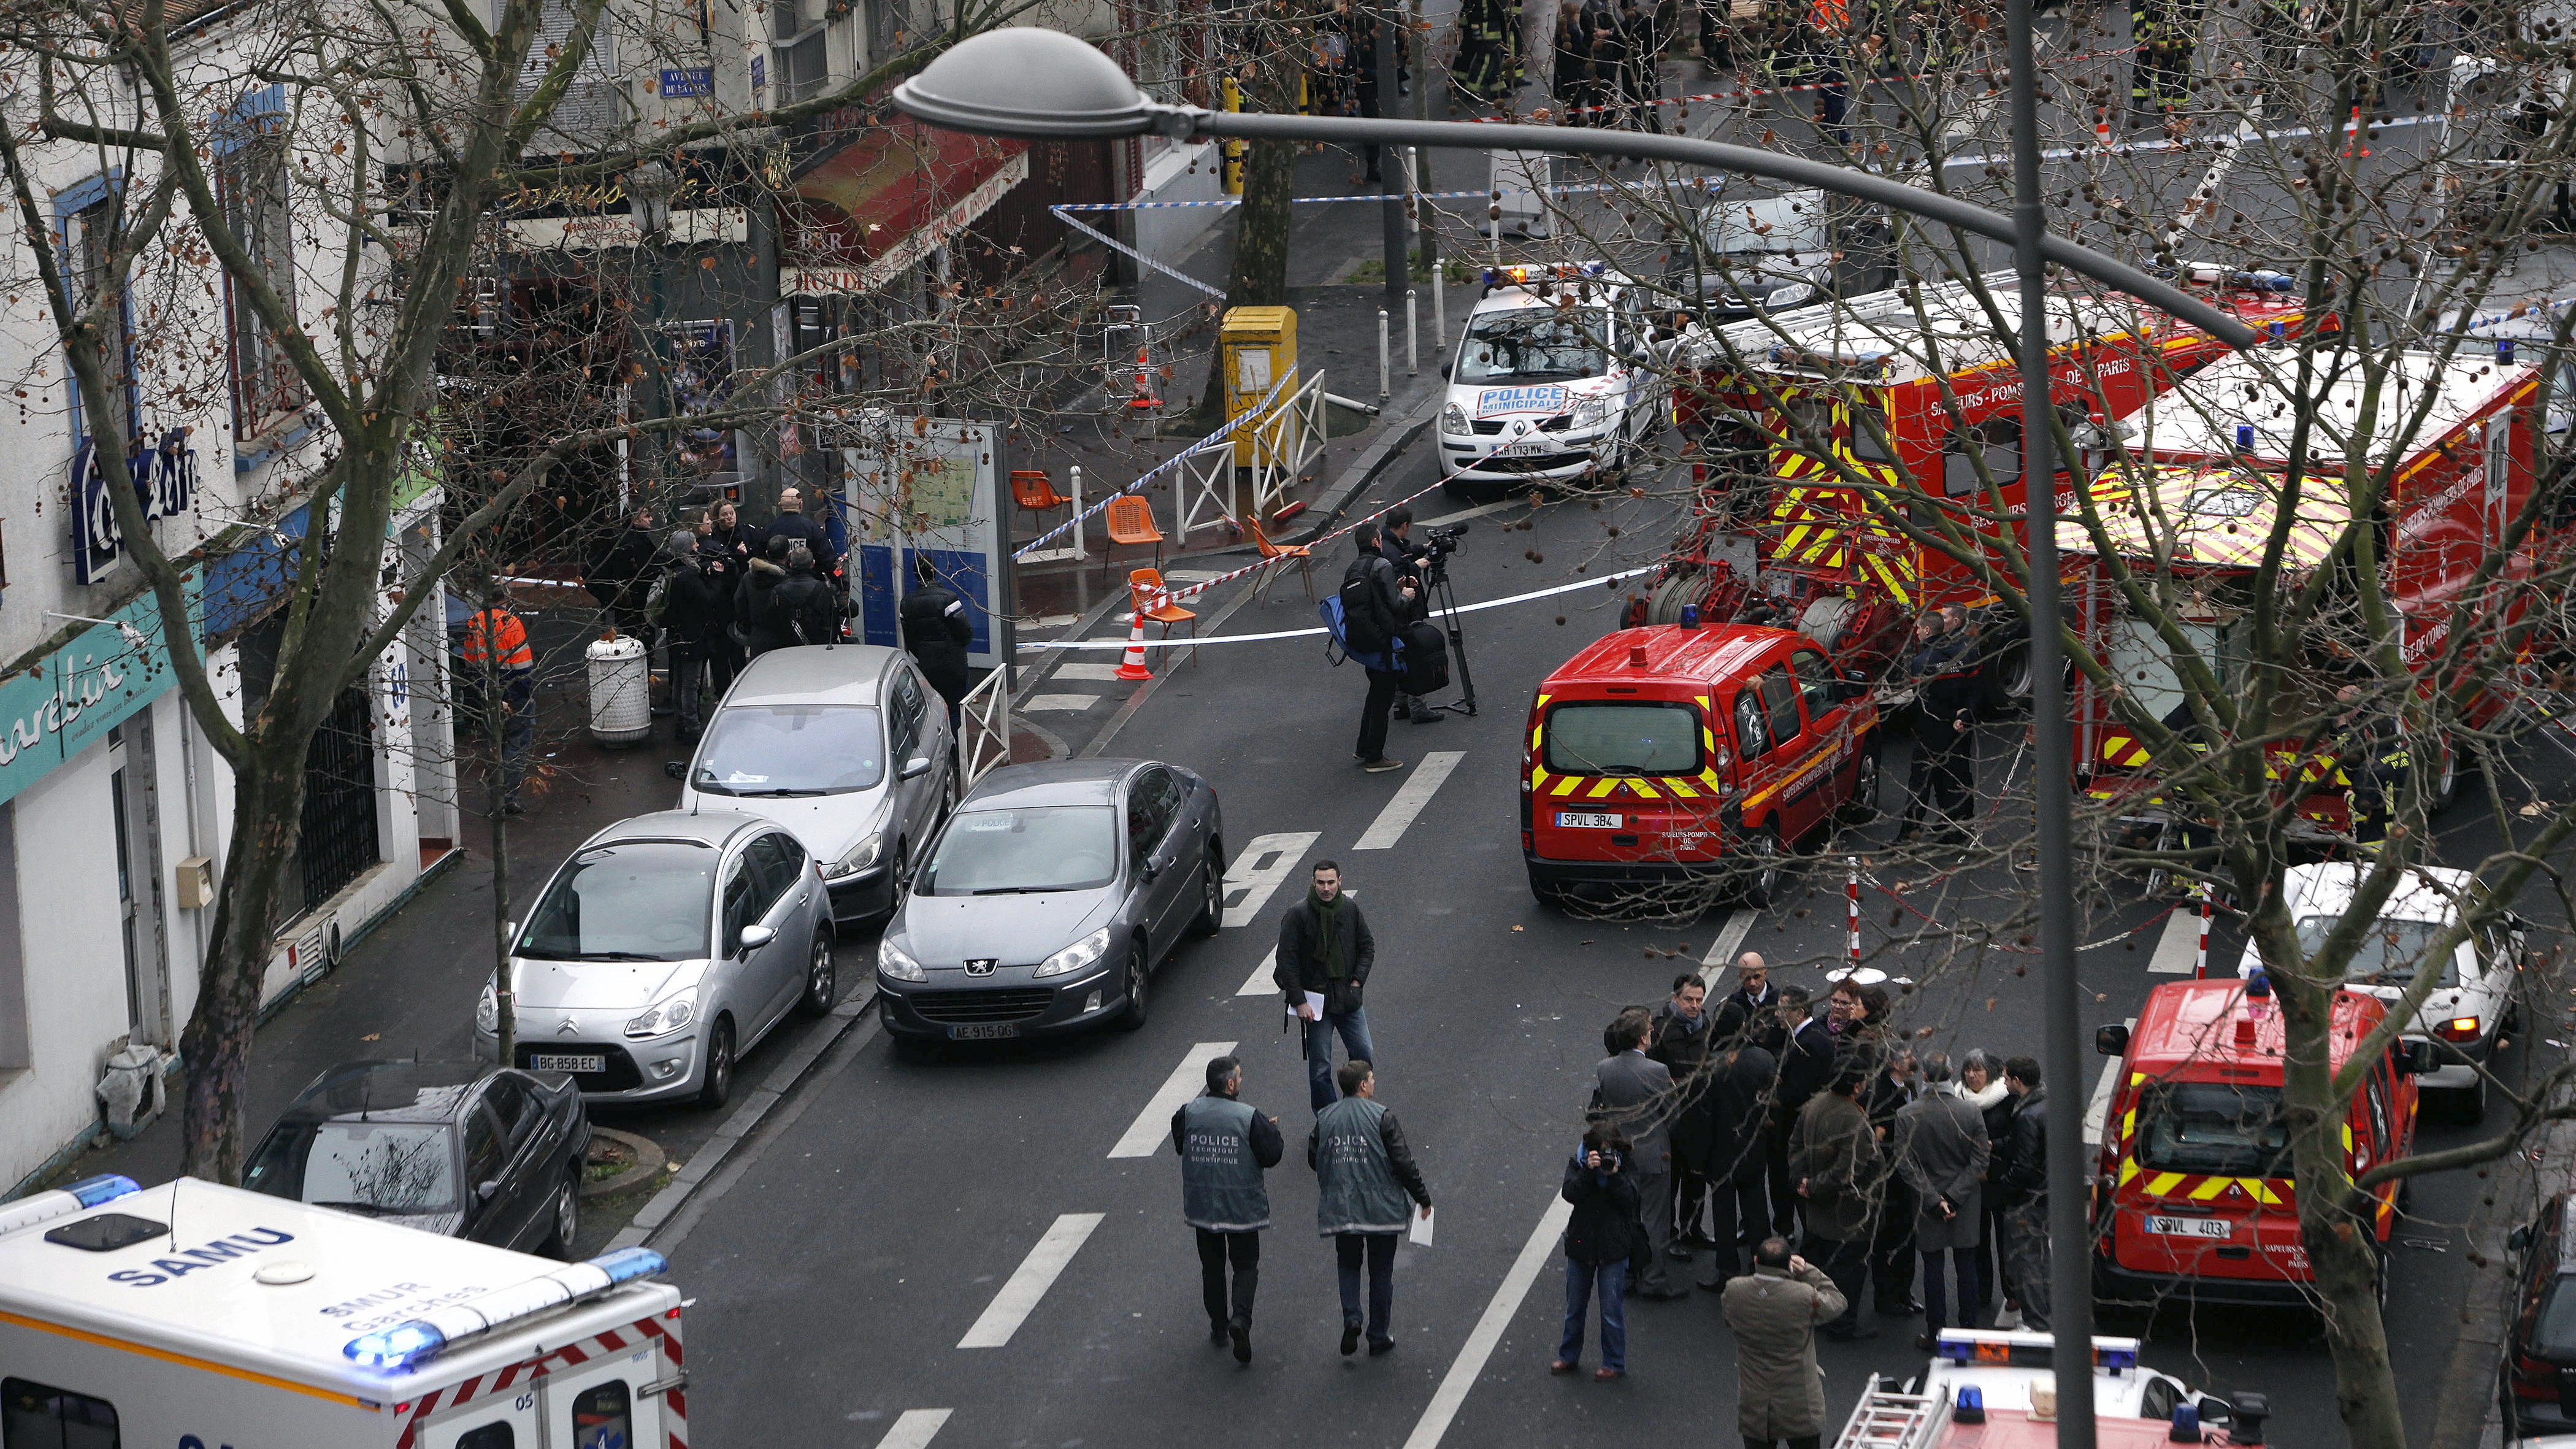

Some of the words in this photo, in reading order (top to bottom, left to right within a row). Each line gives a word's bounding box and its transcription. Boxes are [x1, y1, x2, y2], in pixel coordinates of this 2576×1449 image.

[670, 72, 703, 82] AVEUE
[2066, 369, 2082, 385] DE
[2098, 358, 2129, 378] PARIS
[1484, 388, 1563, 404] POLICE
[1482, 401, 1562, 413] MUNICIPALE
[1931, 393, 1984, 417] SAEURS
[791, 540, 804, 550] ICE
[1754, 726, 1761, 741] 18
[1564, 815, 1590, 826] SPVL
[1594, 816, 1612, 827] 384
[540, 1057, 596, 1070] BG-858-EC
[1190, 1134, 1239, 1147] POLICE
[107, 1227, 295, 1286] SAMU
[318, 1283, 431, 1318] SMUR
[341, 1286, 488, 1331] Garches
[515, 1393, 534, 1411] 05
